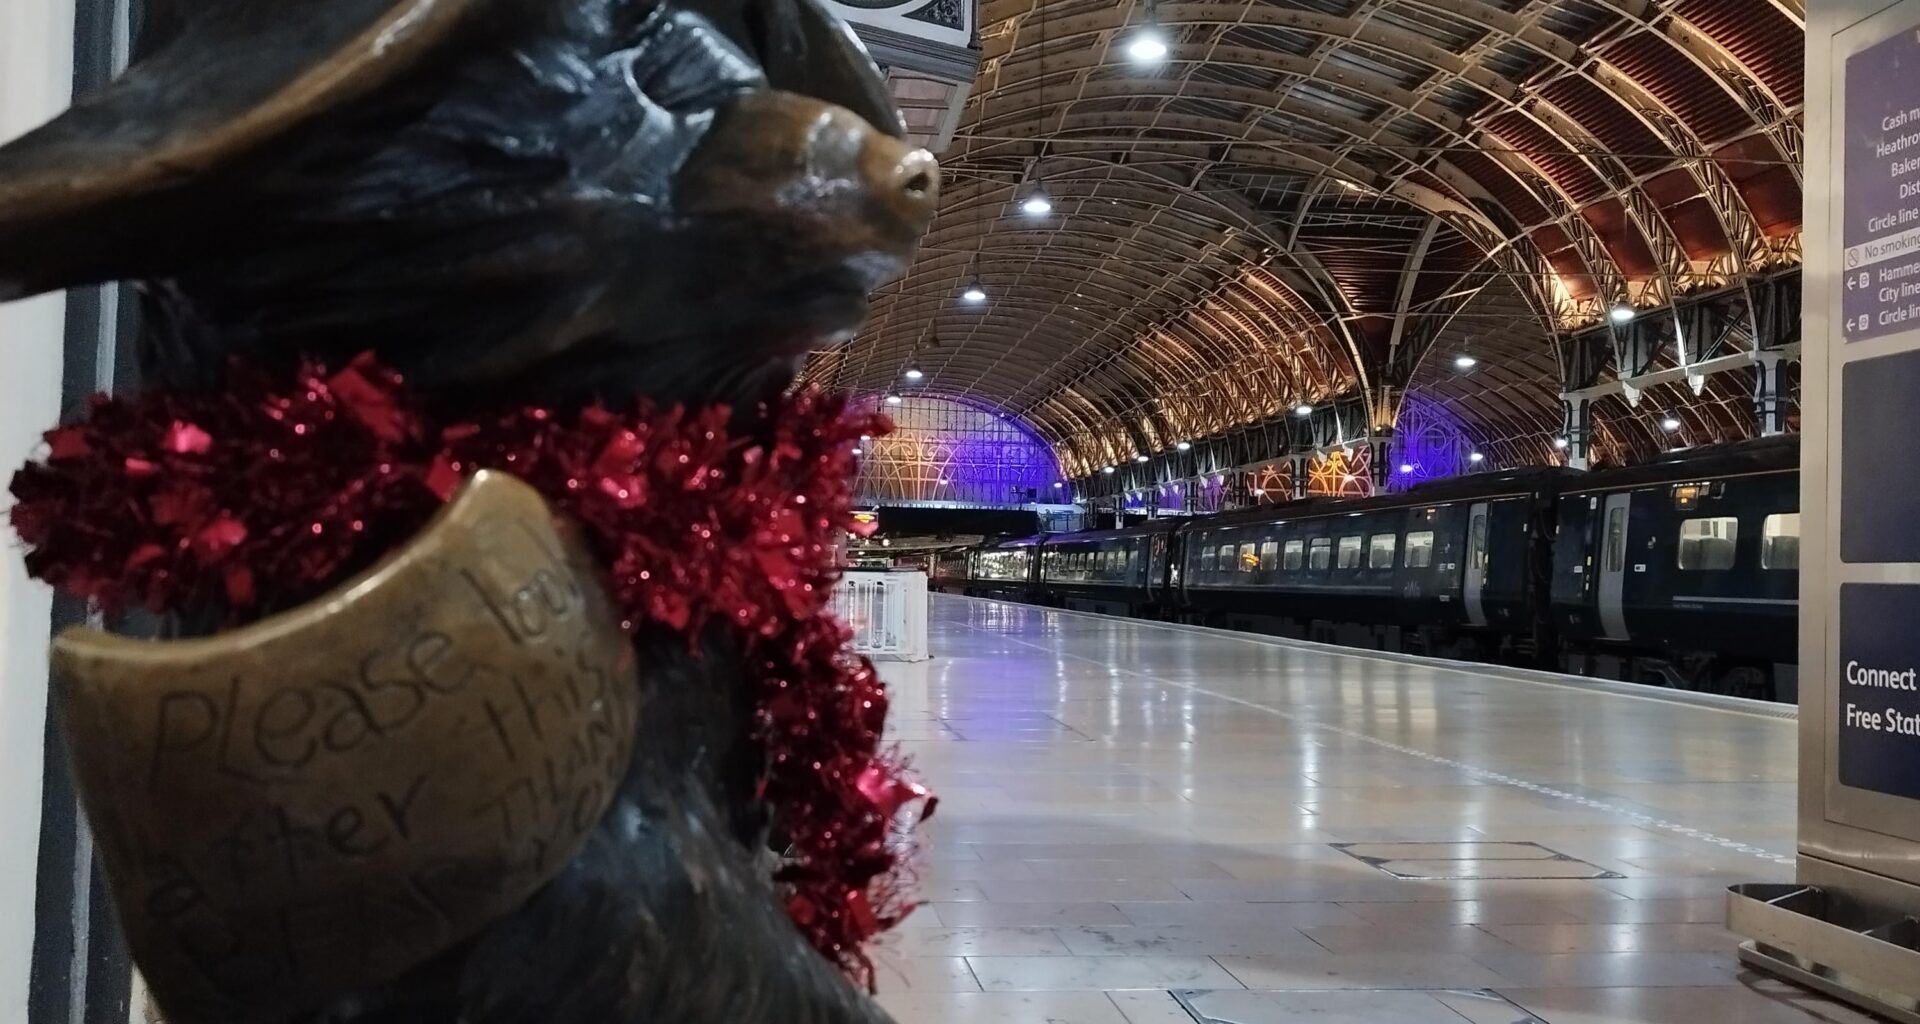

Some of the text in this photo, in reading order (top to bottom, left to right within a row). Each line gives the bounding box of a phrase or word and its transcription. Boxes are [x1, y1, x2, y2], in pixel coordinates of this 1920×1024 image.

[1882, 109, 1907, 131] Cash
[1877, 133, 1920, 158] Heathro
[1868, 208, 1919, 232] Circle line
[1865, 245, 1879, 259] No
[1879, 281, 1920, 303] City line
[1879, 306, 1907, 325] Circle
[1846, 660, 1917, 691] Connect
[1846, 702, 1882, 731] Free
